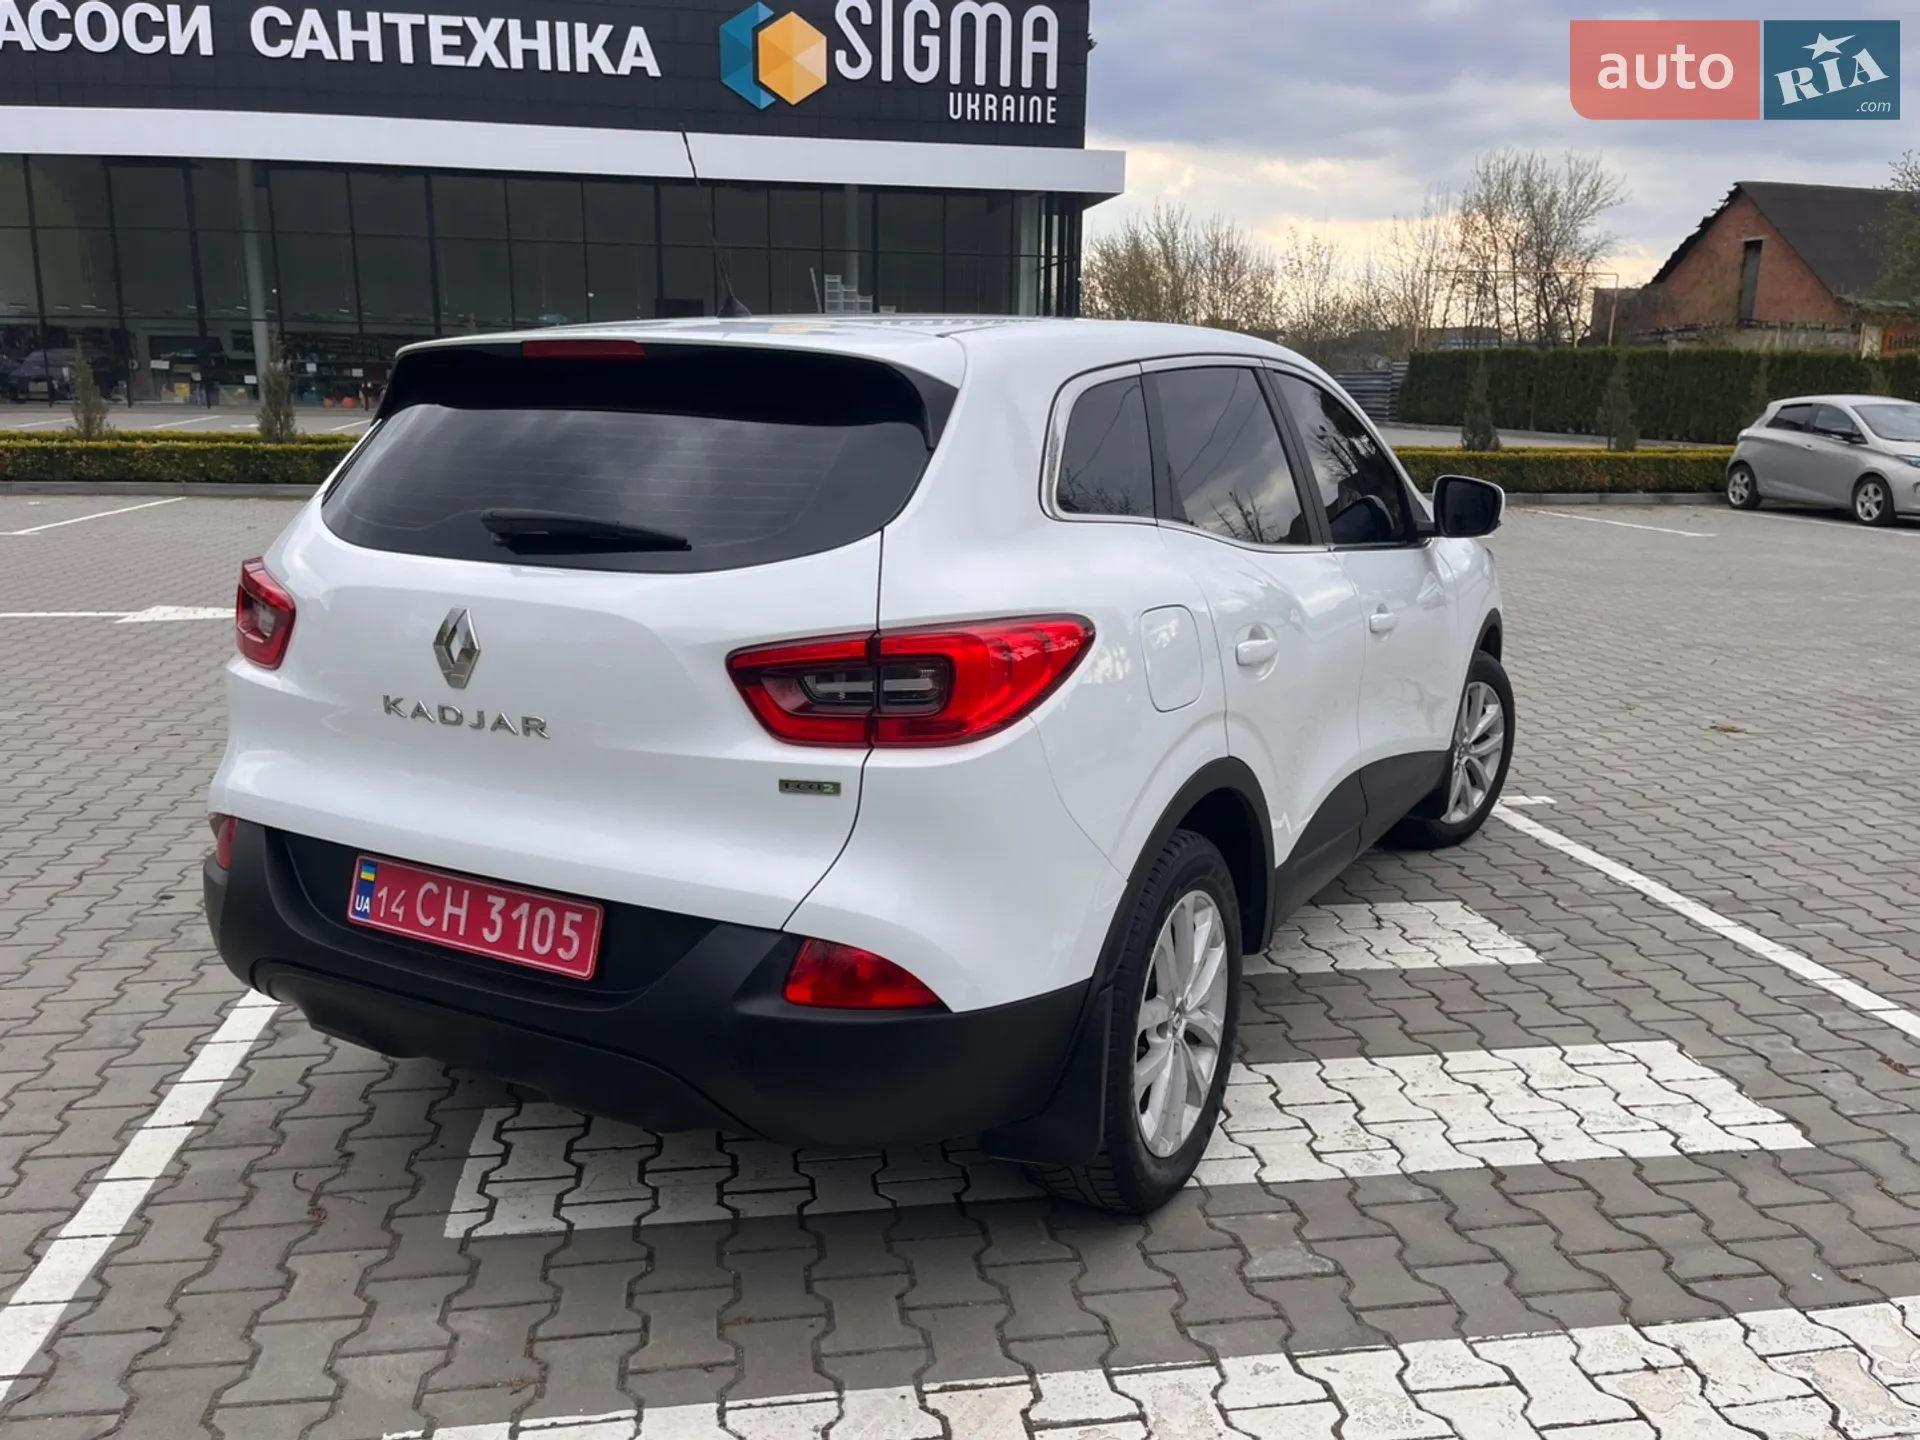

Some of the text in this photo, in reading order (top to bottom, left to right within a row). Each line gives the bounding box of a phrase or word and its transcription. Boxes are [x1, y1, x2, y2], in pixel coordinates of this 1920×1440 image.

[250, 6, 661, 77] САНТЕХНІКА
[834, 0, 1059, 89] SIGMA
[949, 92, 1057, 124] UKRAINE
[383, 694, 551, 740] KADJAR
[355, 894, 370, 912] UA
[377, 886, 406, 922] 14
[482, 894, 583, 961] 3105
